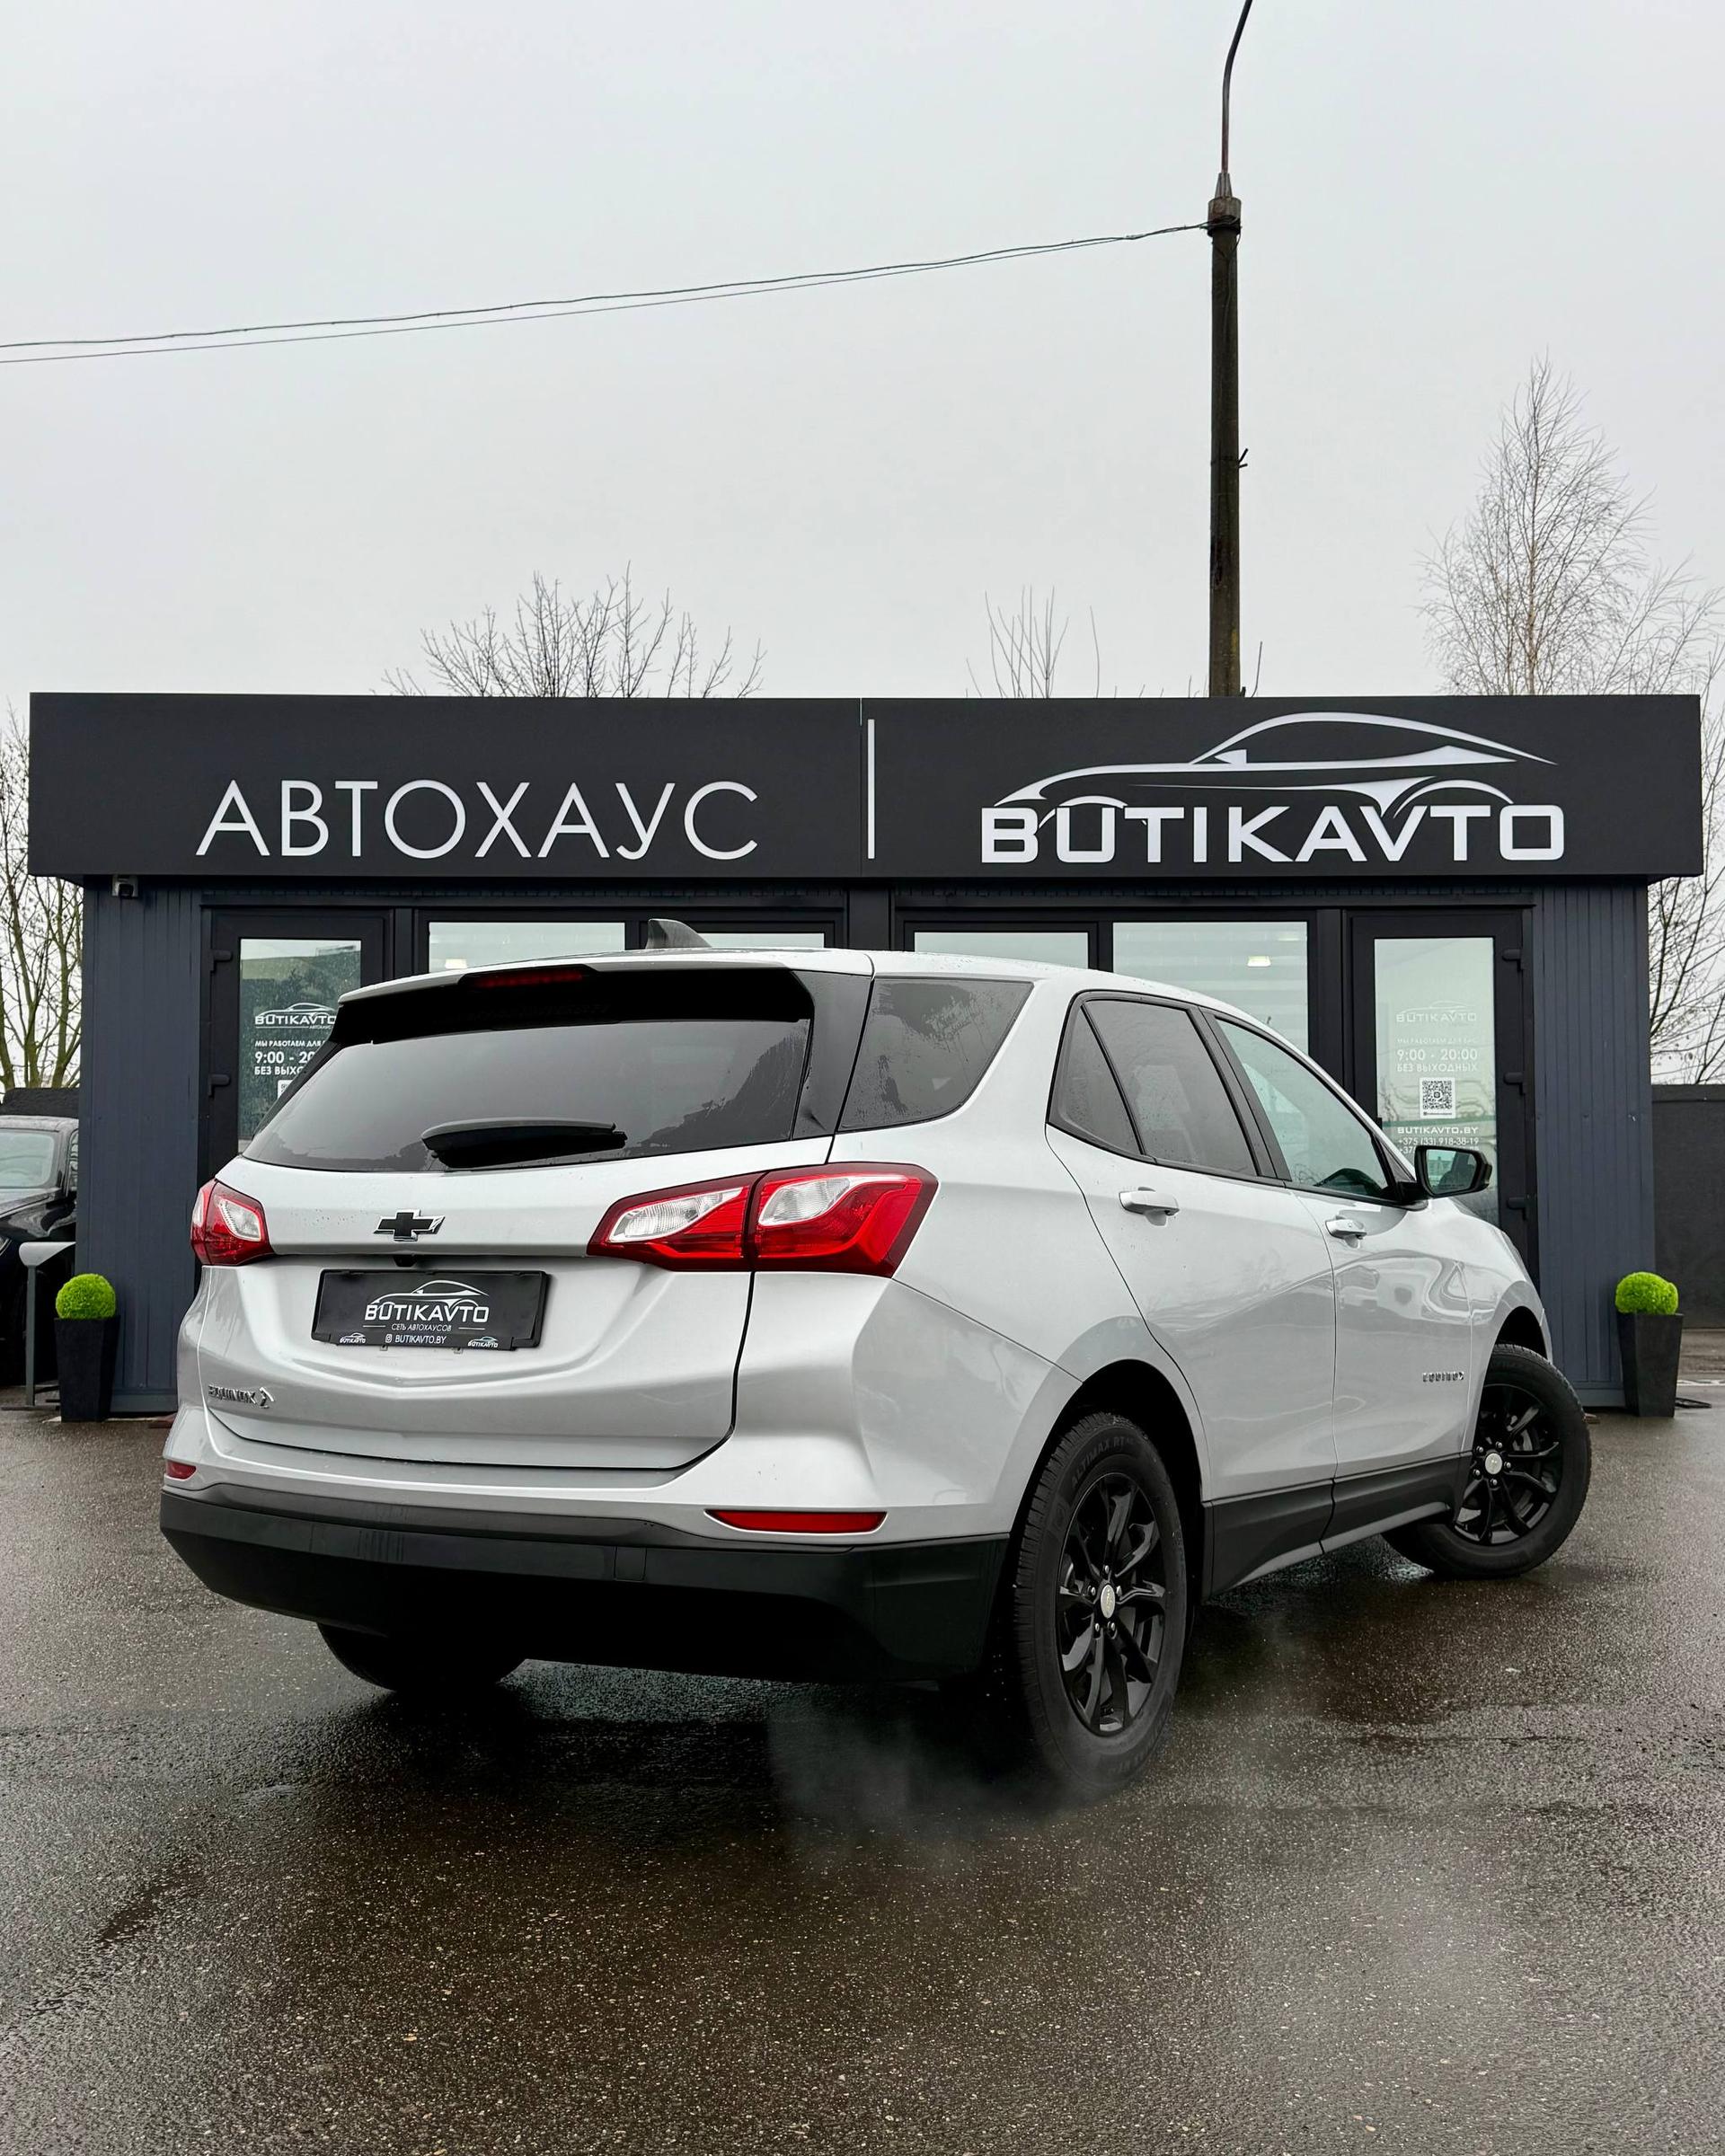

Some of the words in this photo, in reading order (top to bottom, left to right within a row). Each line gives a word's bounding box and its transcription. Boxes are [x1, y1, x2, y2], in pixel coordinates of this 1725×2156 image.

[196, 780, 759, 861] АВТОХАУС
[981, 803, 1564, 864] BUTIKAVTO
[1396, 1012, 1477, 1022] BUTIKAVTO
[255, 1051, 285, 1064] 9:00
[1397, 1048, 1426, 1061] 9:00
[1440, 1048, 1478, 1061] 20:00
[254, 1066, 271, 1075] БЕЗ
[1397, 1063, 1413, 1072] БЕЗ
[1417, 1063, 1478, 1072] ВЫХОДНЫХ
[1398, 1137, 1419, 1145] +375
[1420, 1137, 1436, 1145] (33)
[364, 1303, 490, 1323] BUTIKAVTO
[407, 1324, 452, 1332] АВТОХАУСОВ
[395, 1335, 447, 1345] BUTIKAVTO.BY
